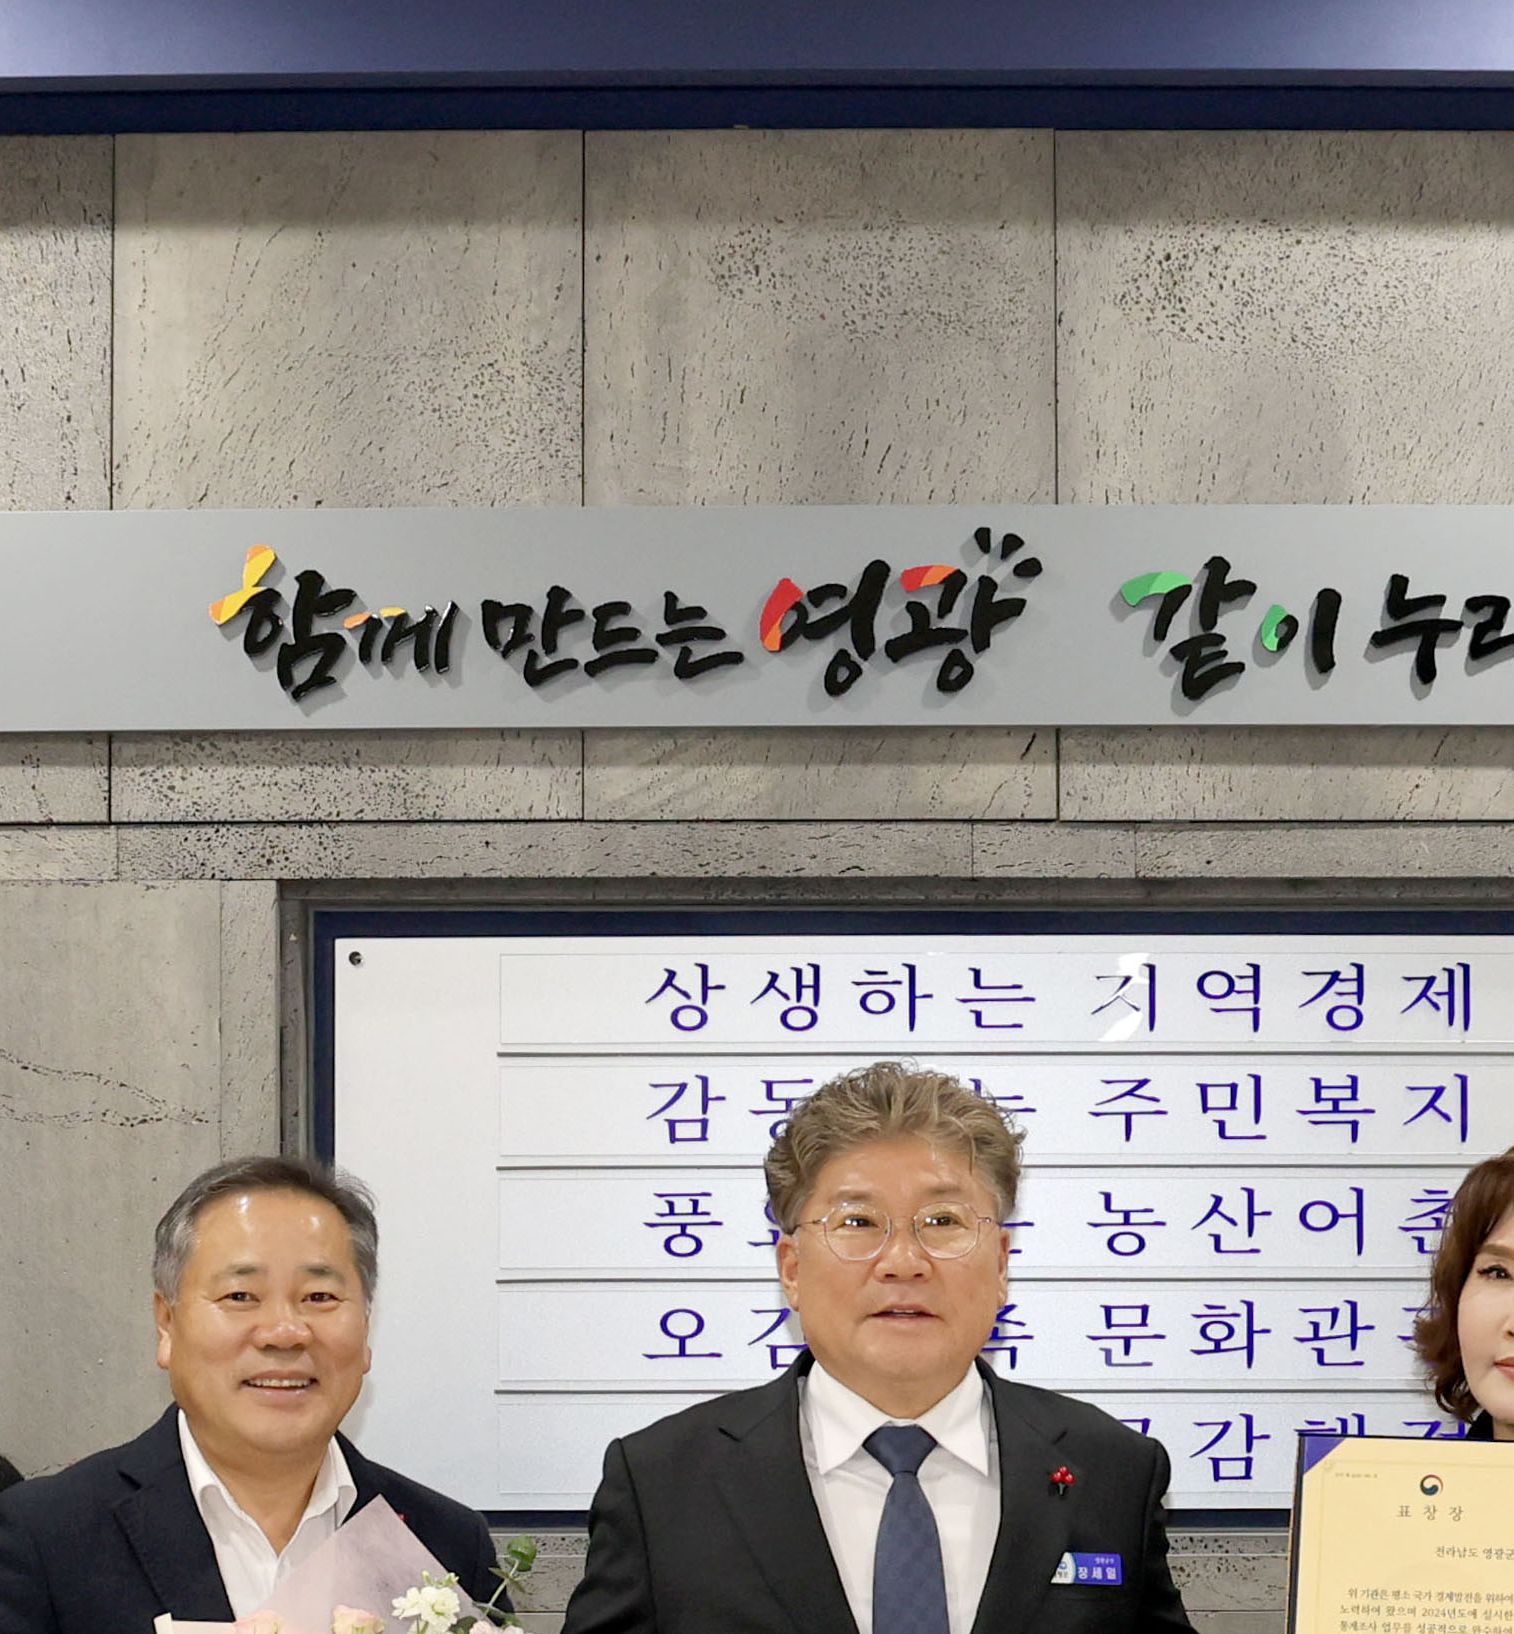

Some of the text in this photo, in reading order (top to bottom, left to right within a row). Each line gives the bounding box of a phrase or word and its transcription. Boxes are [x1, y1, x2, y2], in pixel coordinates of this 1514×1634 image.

[209, 544, 459, 701] 함께
[481, 585, 744, 680] 만드는
[760, 557, 1031, 697] 영광
[1121, 555, 1342, 701] 같이
[645, 963, 1471, 1033] 상생하는 지역경제
[1088, 1073, 1469, 1144] 주민복지
[1086, 1299, 1446, 1369] 문화관
